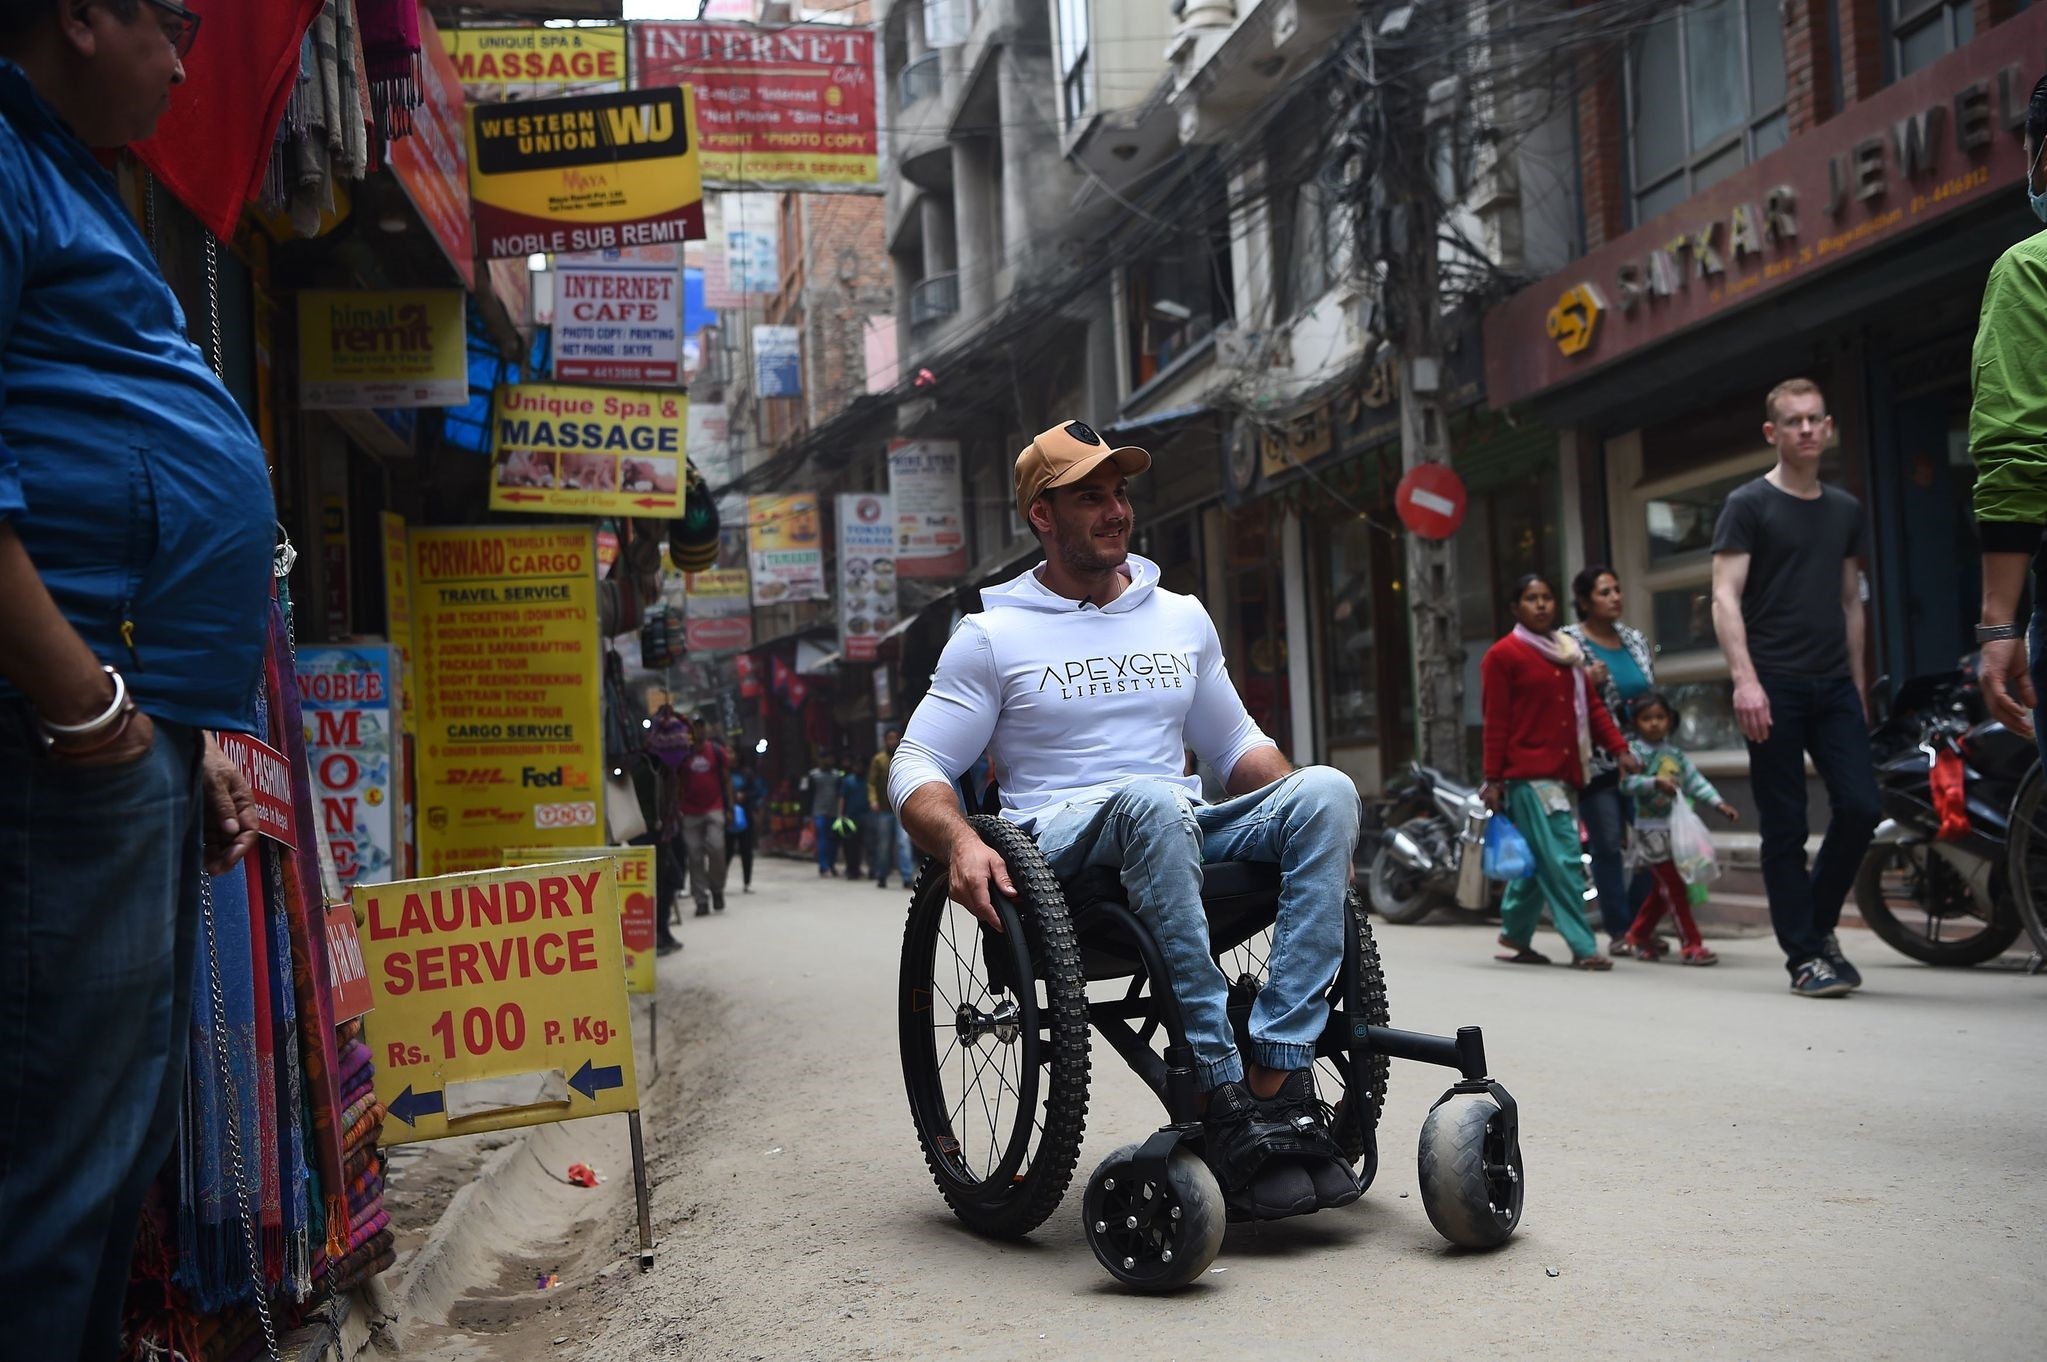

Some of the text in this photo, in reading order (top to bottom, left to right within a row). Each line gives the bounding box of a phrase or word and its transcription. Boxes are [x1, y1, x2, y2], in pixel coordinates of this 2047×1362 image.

[479, 36, 583, 48] UNIQUE SPA &
[645, 29, 865, 64] INTERNET
[450, 52, 616, 78] MASSAGE
[832, 67, 866, 86] Cafe
[481, 111, 594, 138] WESTERN
[735, 110, 781, 123] Phone
[519, 131, 596, 154] UNION
[824, 134, 867, 148] COPY
[746, 162, 805, 174] COURIER
[811, 162, 866, 175] SERVICE
[492, 232, 566, 256] NOBLE
[572, 227, 615, 250] SUB
[622, 219, 687, 245] REMIT
[1616, 184, 1801, 310] SATKAR
[564, 275, 673, 300] INTERNET
[330, 304, 394, 326] himal
[573, 303, 658, 322] CAFE
[332, 309, 434, 352] remit
[563, 327, 594, 339] PHOTO
[597, 328, 622, 340] COPY
[630, 329, 674, 341] PRINTING
[562, 344, 580, 355] NET
[583, 345, 614, 356] PHONE
[623, 345, 653, 356] SKYPE
[503, 392, 678, 421] Unique Spa &
[502, 418, 678, 452] MASSAGE
[417, 538, 506, 578] FORWARD
[509, 553, 582, 575] CARGO
[438, 585, 570, 602] TRAVEL SERVICE
[460, 610, 520, 623] TICKETING
[503, 625, 544, 638] FLIGHT
[439, 658, 529, 670] PACKAGE TOUR
[1040, 653, 1191, 690] APEXGEN
[296, 673, 381, 701] NOBLE
[505, 690, 546, 702] TICKET
[1062, 677, 1182, 699] LIFESTYLE
[441, 706, 473, 717] TIBET
[532, 706, 563, 718] TOUR
[447, 724, 573, 737] CARGO SERVICE
[252, 748, 292, 806] PASHMINA
[446, 765, 588, 788] DHL FedEx
[275, 807, 288, 832] Nepal
[617, 861, 648, 881] FE
[367, 872, 601, 941] LAUNDRY
[384, 928, 598, 996] SERVICE
[388, 1002, 616, 1067] Rs. 100 P. Kg.
